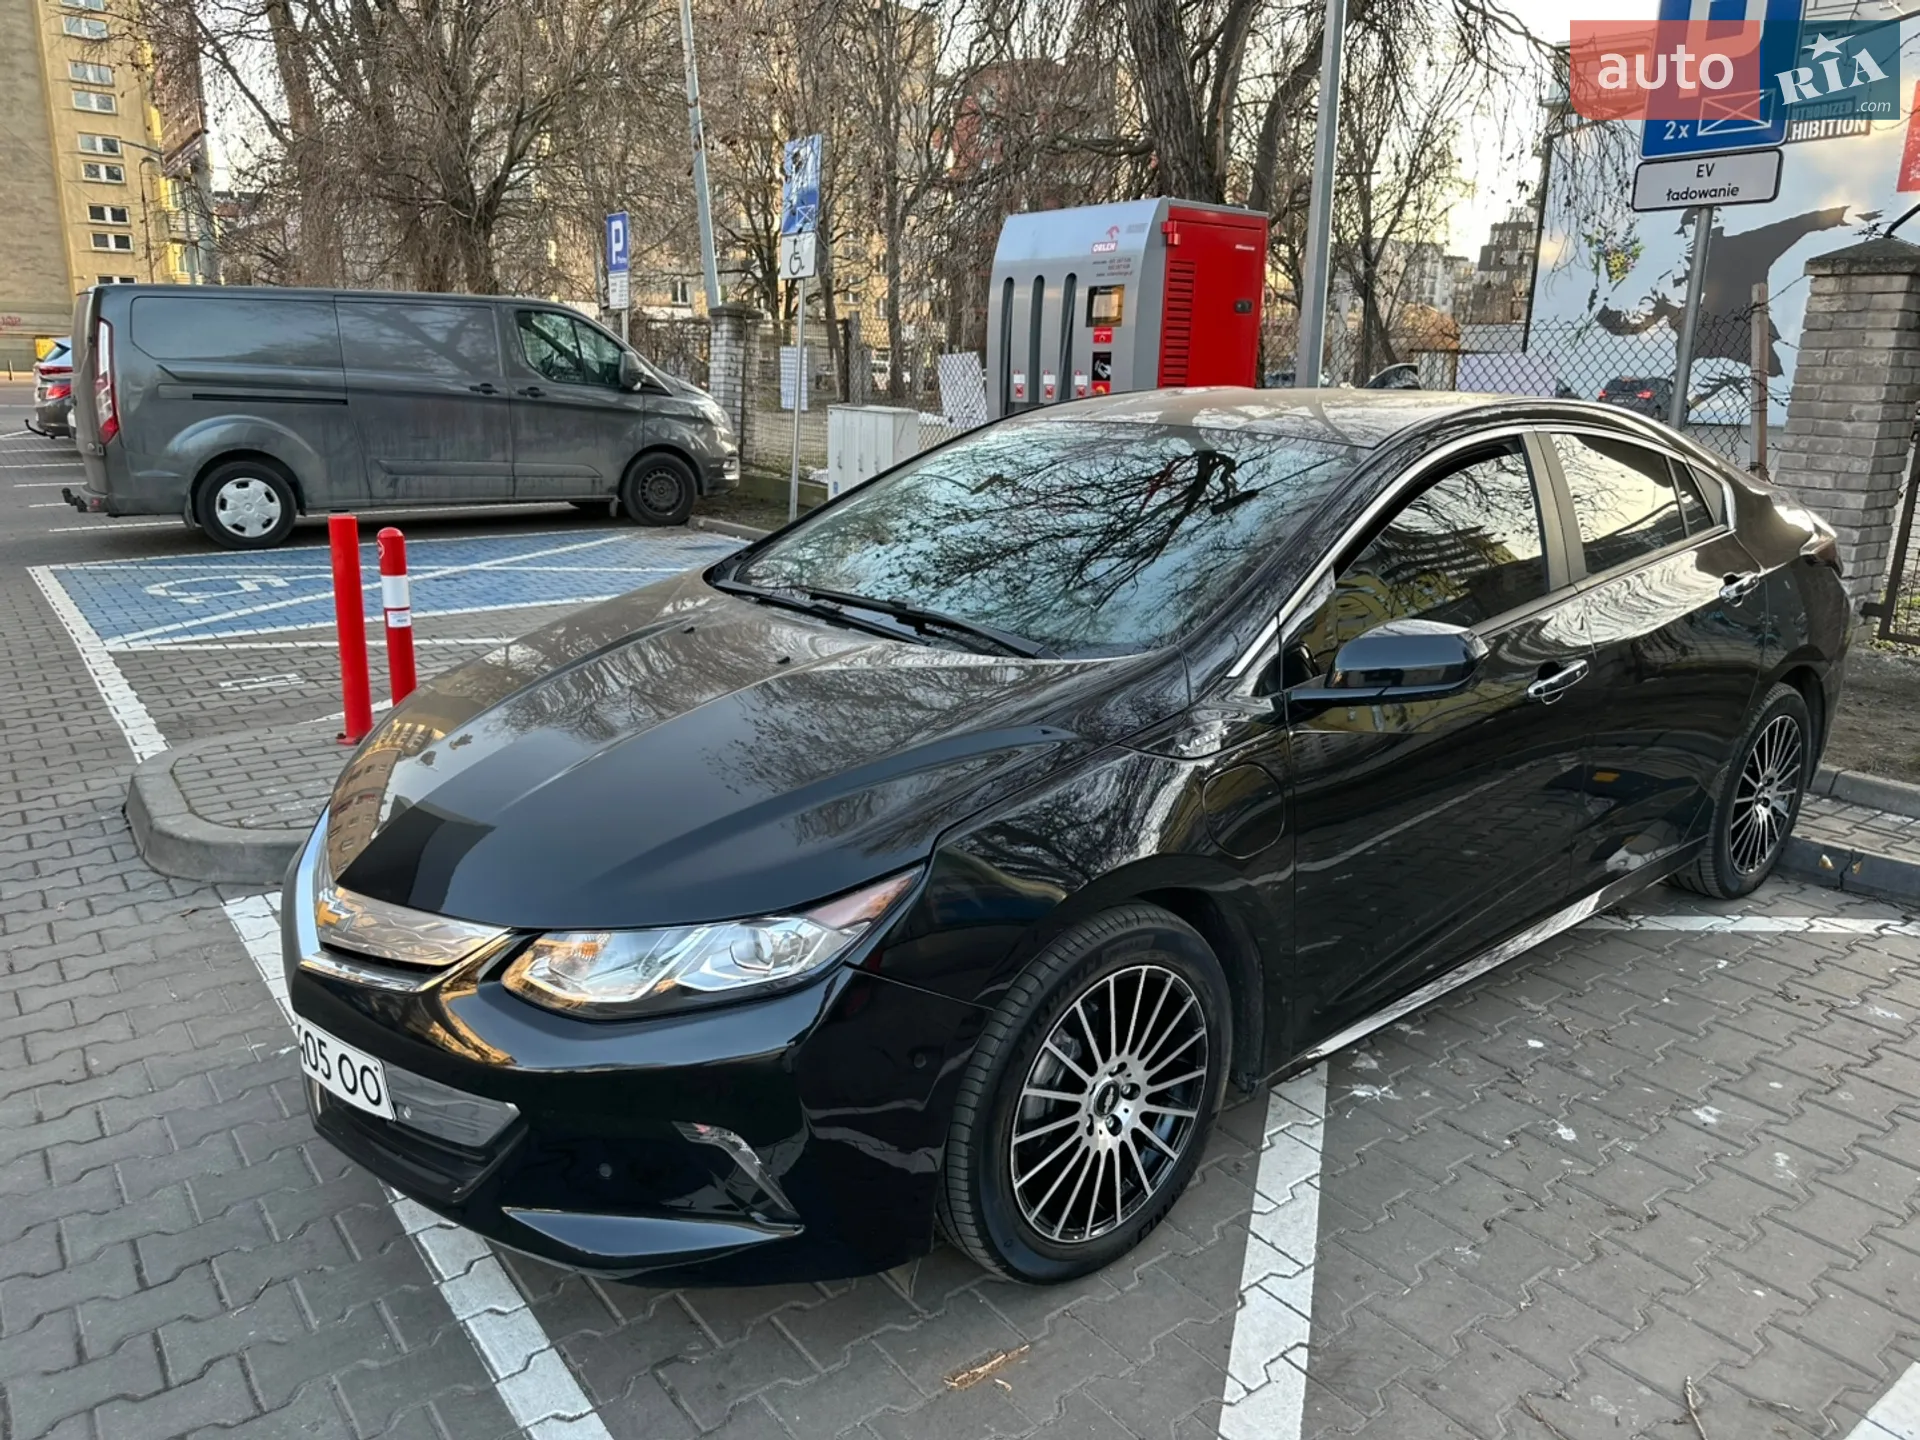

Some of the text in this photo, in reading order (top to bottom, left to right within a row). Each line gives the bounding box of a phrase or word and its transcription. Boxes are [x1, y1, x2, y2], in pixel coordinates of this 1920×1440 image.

[1787, 113, 1867, 141] HIBITION
[1696, 163, 1715, 178] EV
[1666, 183, 1740, 201] ładowanie
[611, 220, 624, 265] P
